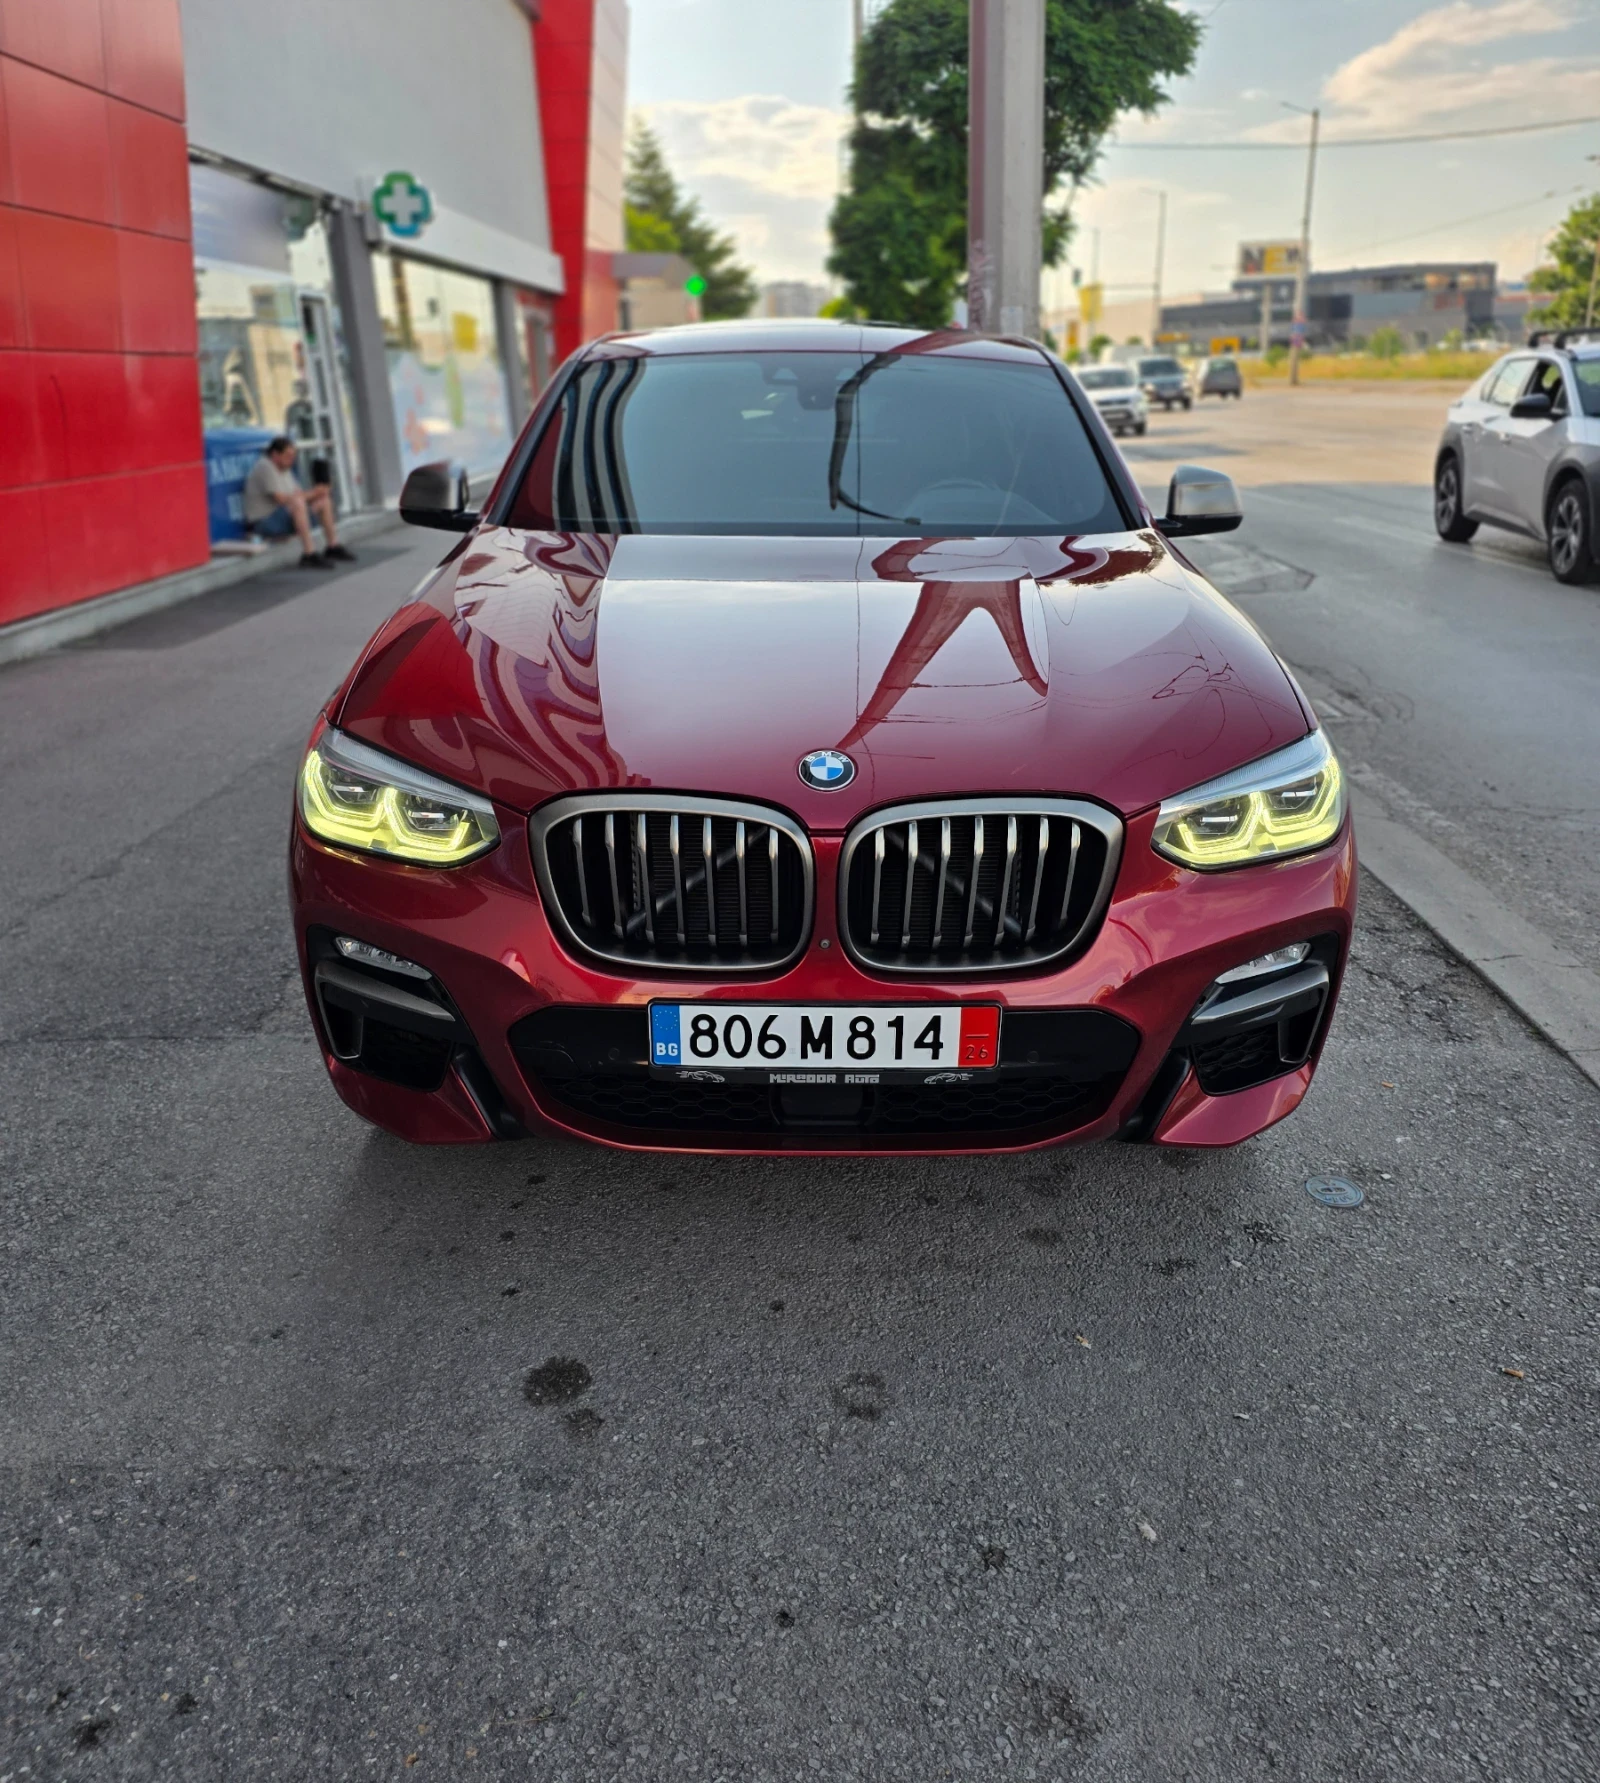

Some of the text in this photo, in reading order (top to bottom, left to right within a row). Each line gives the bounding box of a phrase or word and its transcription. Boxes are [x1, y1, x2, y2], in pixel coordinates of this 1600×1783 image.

[804, 751, 850, 763] BMW
[690, 1014, 944, 1060] 806 M 814
[656, 1042, 679, 1057] BG
[965, 1044, 989, 1060] 26
